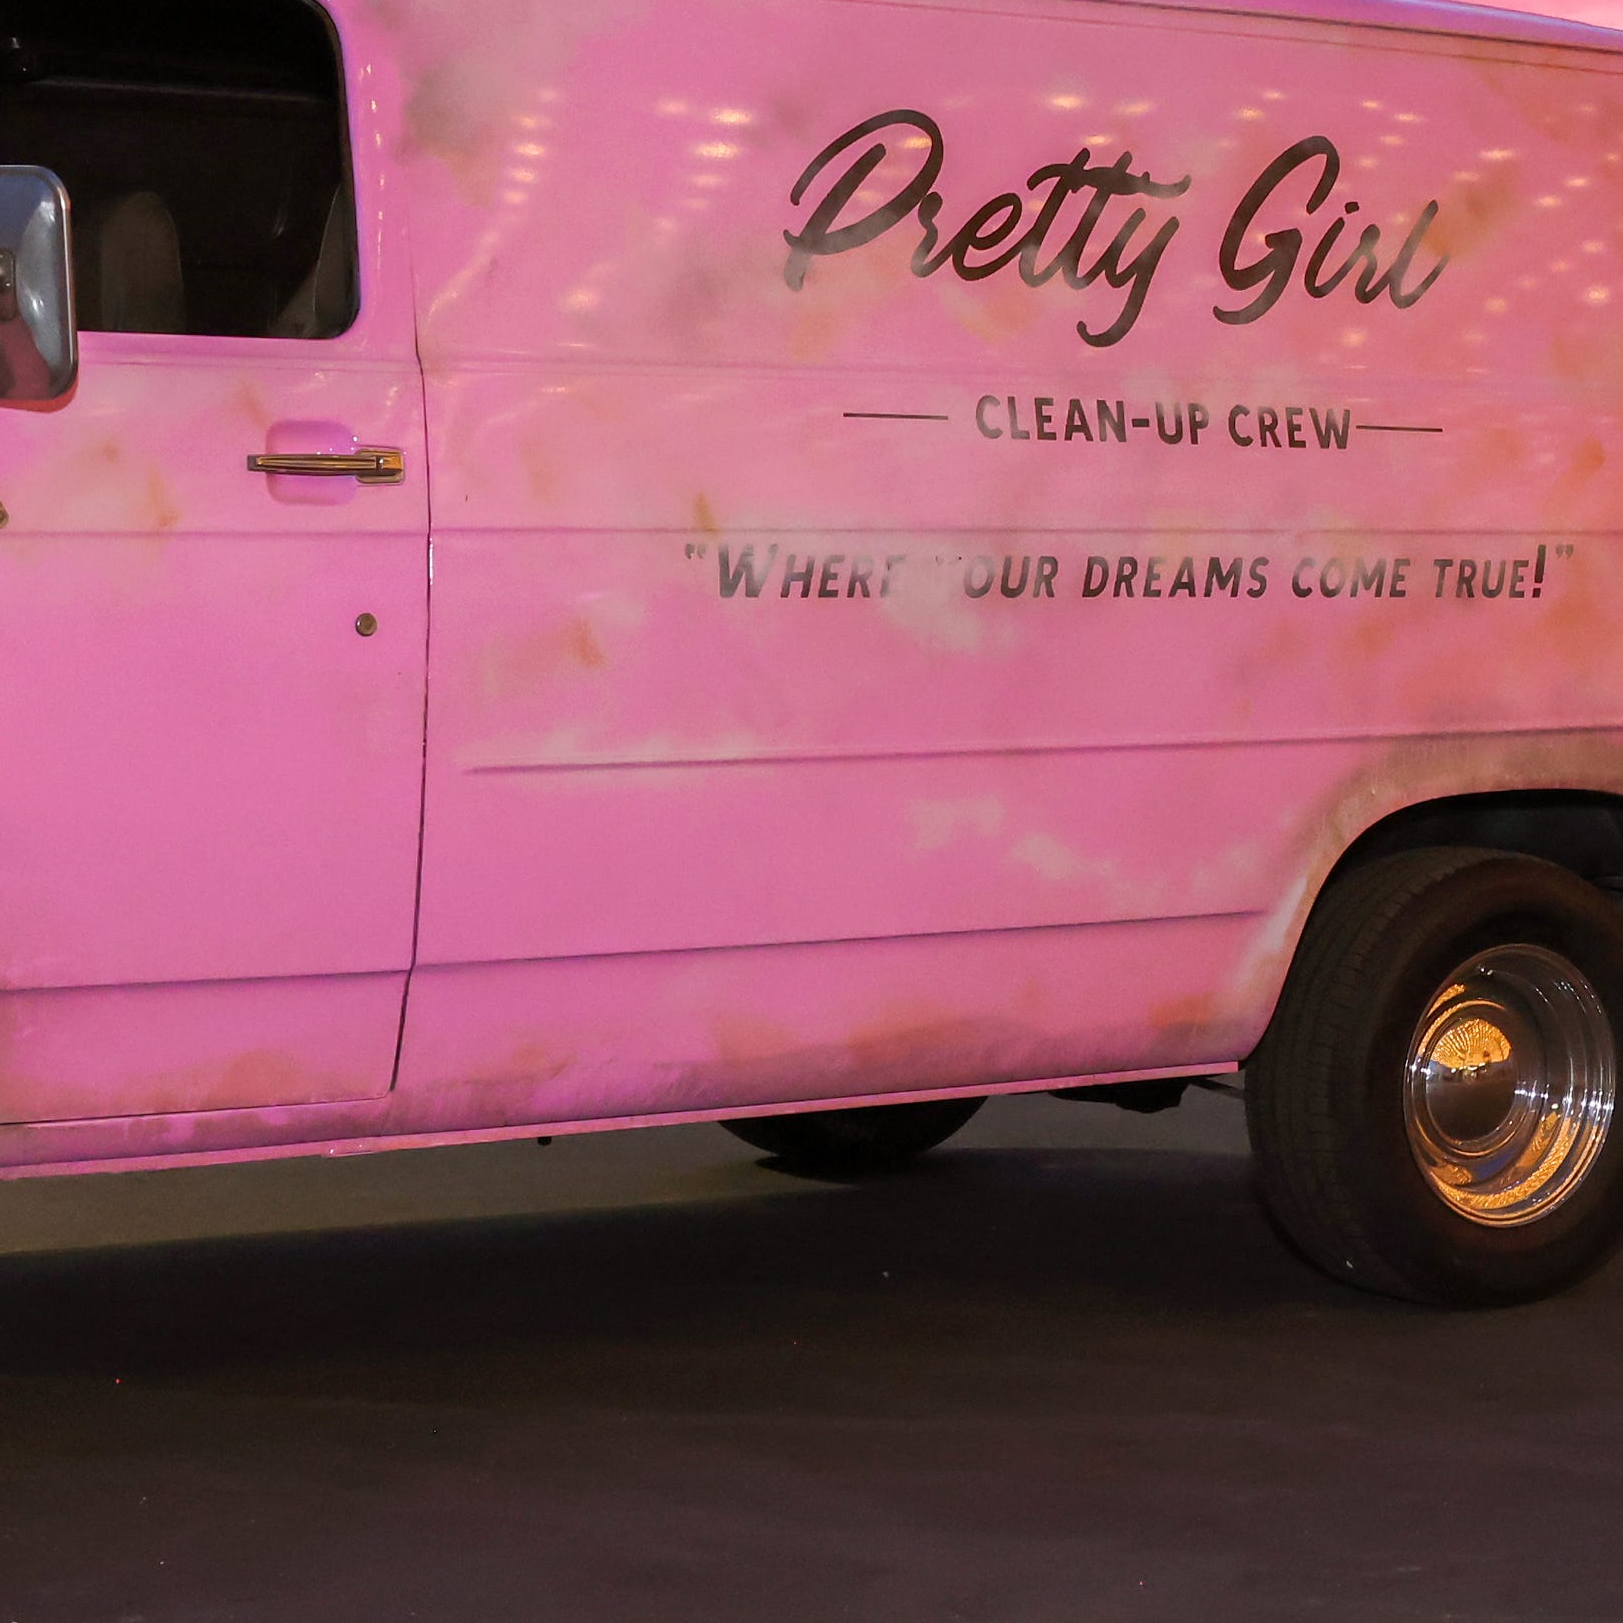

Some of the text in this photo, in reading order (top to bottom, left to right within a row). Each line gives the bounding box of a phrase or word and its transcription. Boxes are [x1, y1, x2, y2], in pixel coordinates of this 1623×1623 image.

[783, 108, 1451, 348] Pretty Girl
[975, 394, 1351, 450] CLEAN-UP CREW
[935, 554, 1060, 599] OUR
[1081, 555, 1270, 599] DREAMS
[1290, 556, 1411, 599] COME
[1433, 543, 1575, 599] TRUE!"
